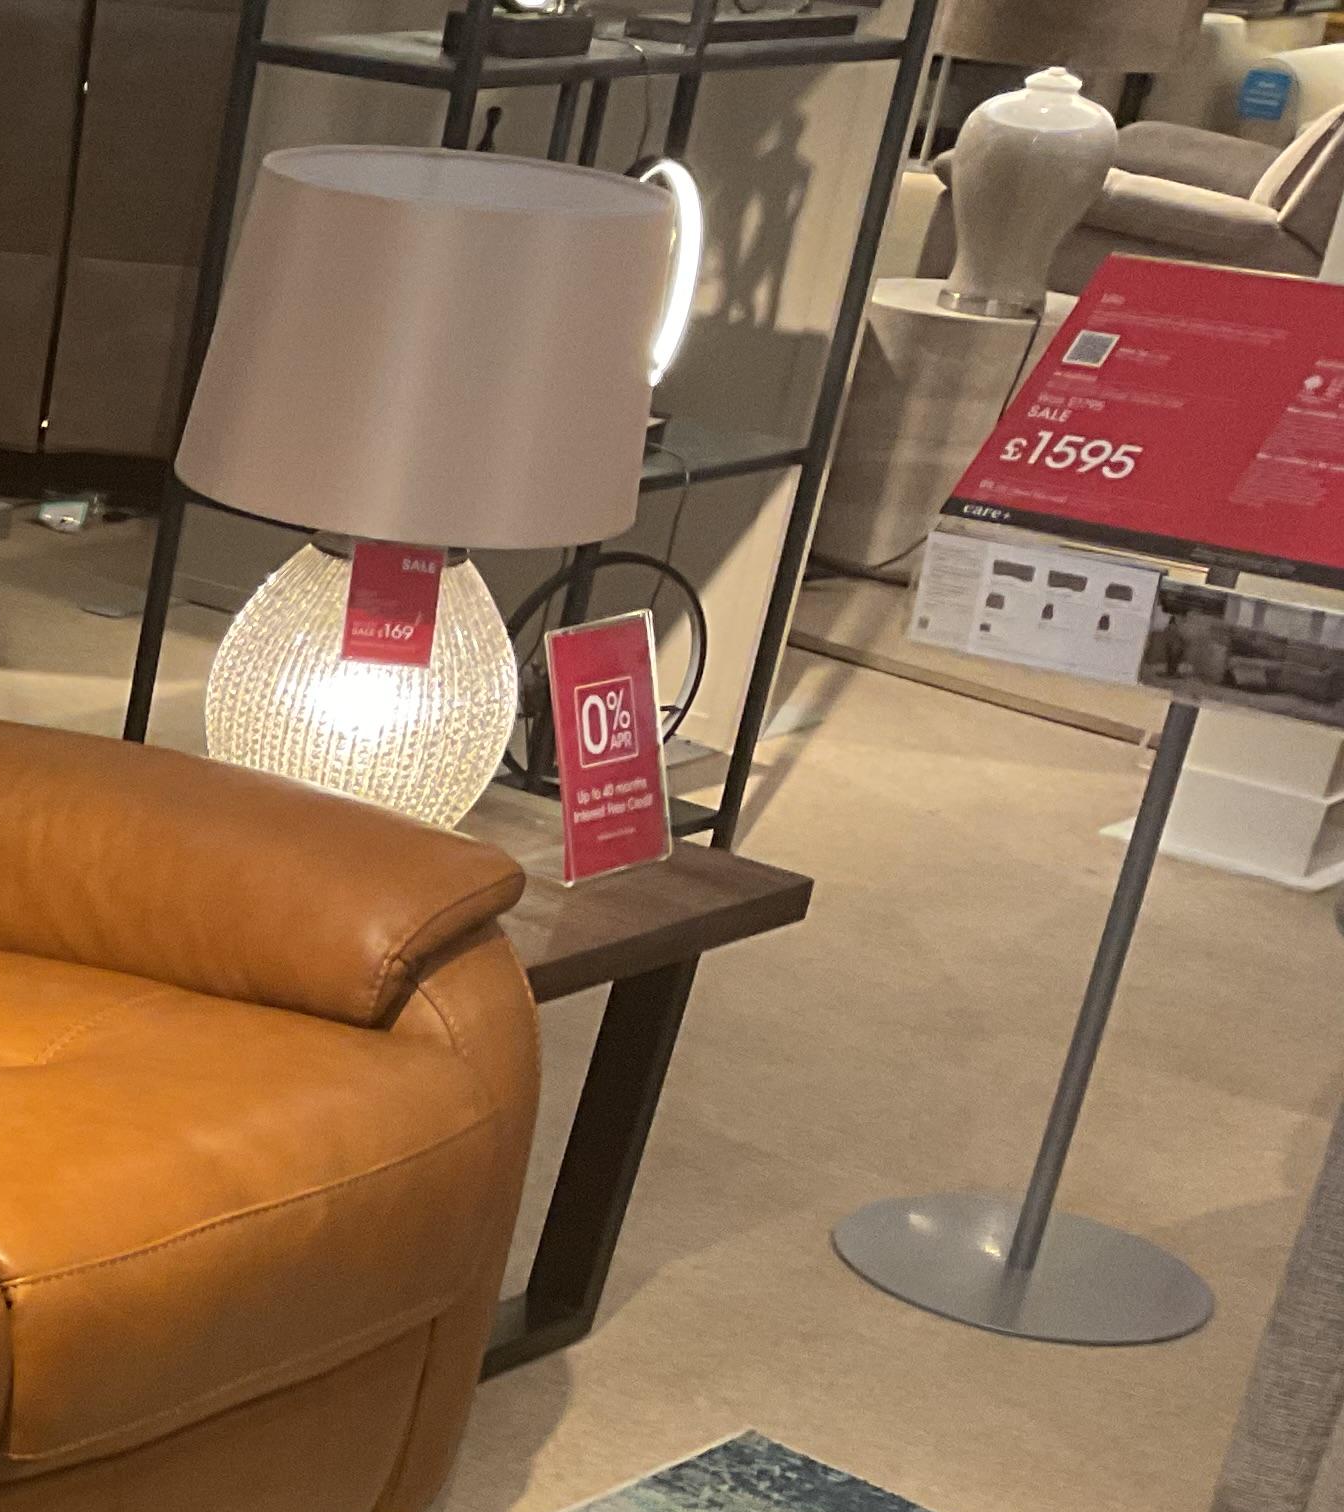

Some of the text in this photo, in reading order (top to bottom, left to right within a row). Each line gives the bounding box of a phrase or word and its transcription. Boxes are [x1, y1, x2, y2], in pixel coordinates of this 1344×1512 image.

[1027, 403, 1073, 423] SALE
[999, 429, 1144, 479] £1595
[401, 557, 437, 574] SALE
[581, 690, 631, 754] 0%
[610, 730, 633, 749] APR
